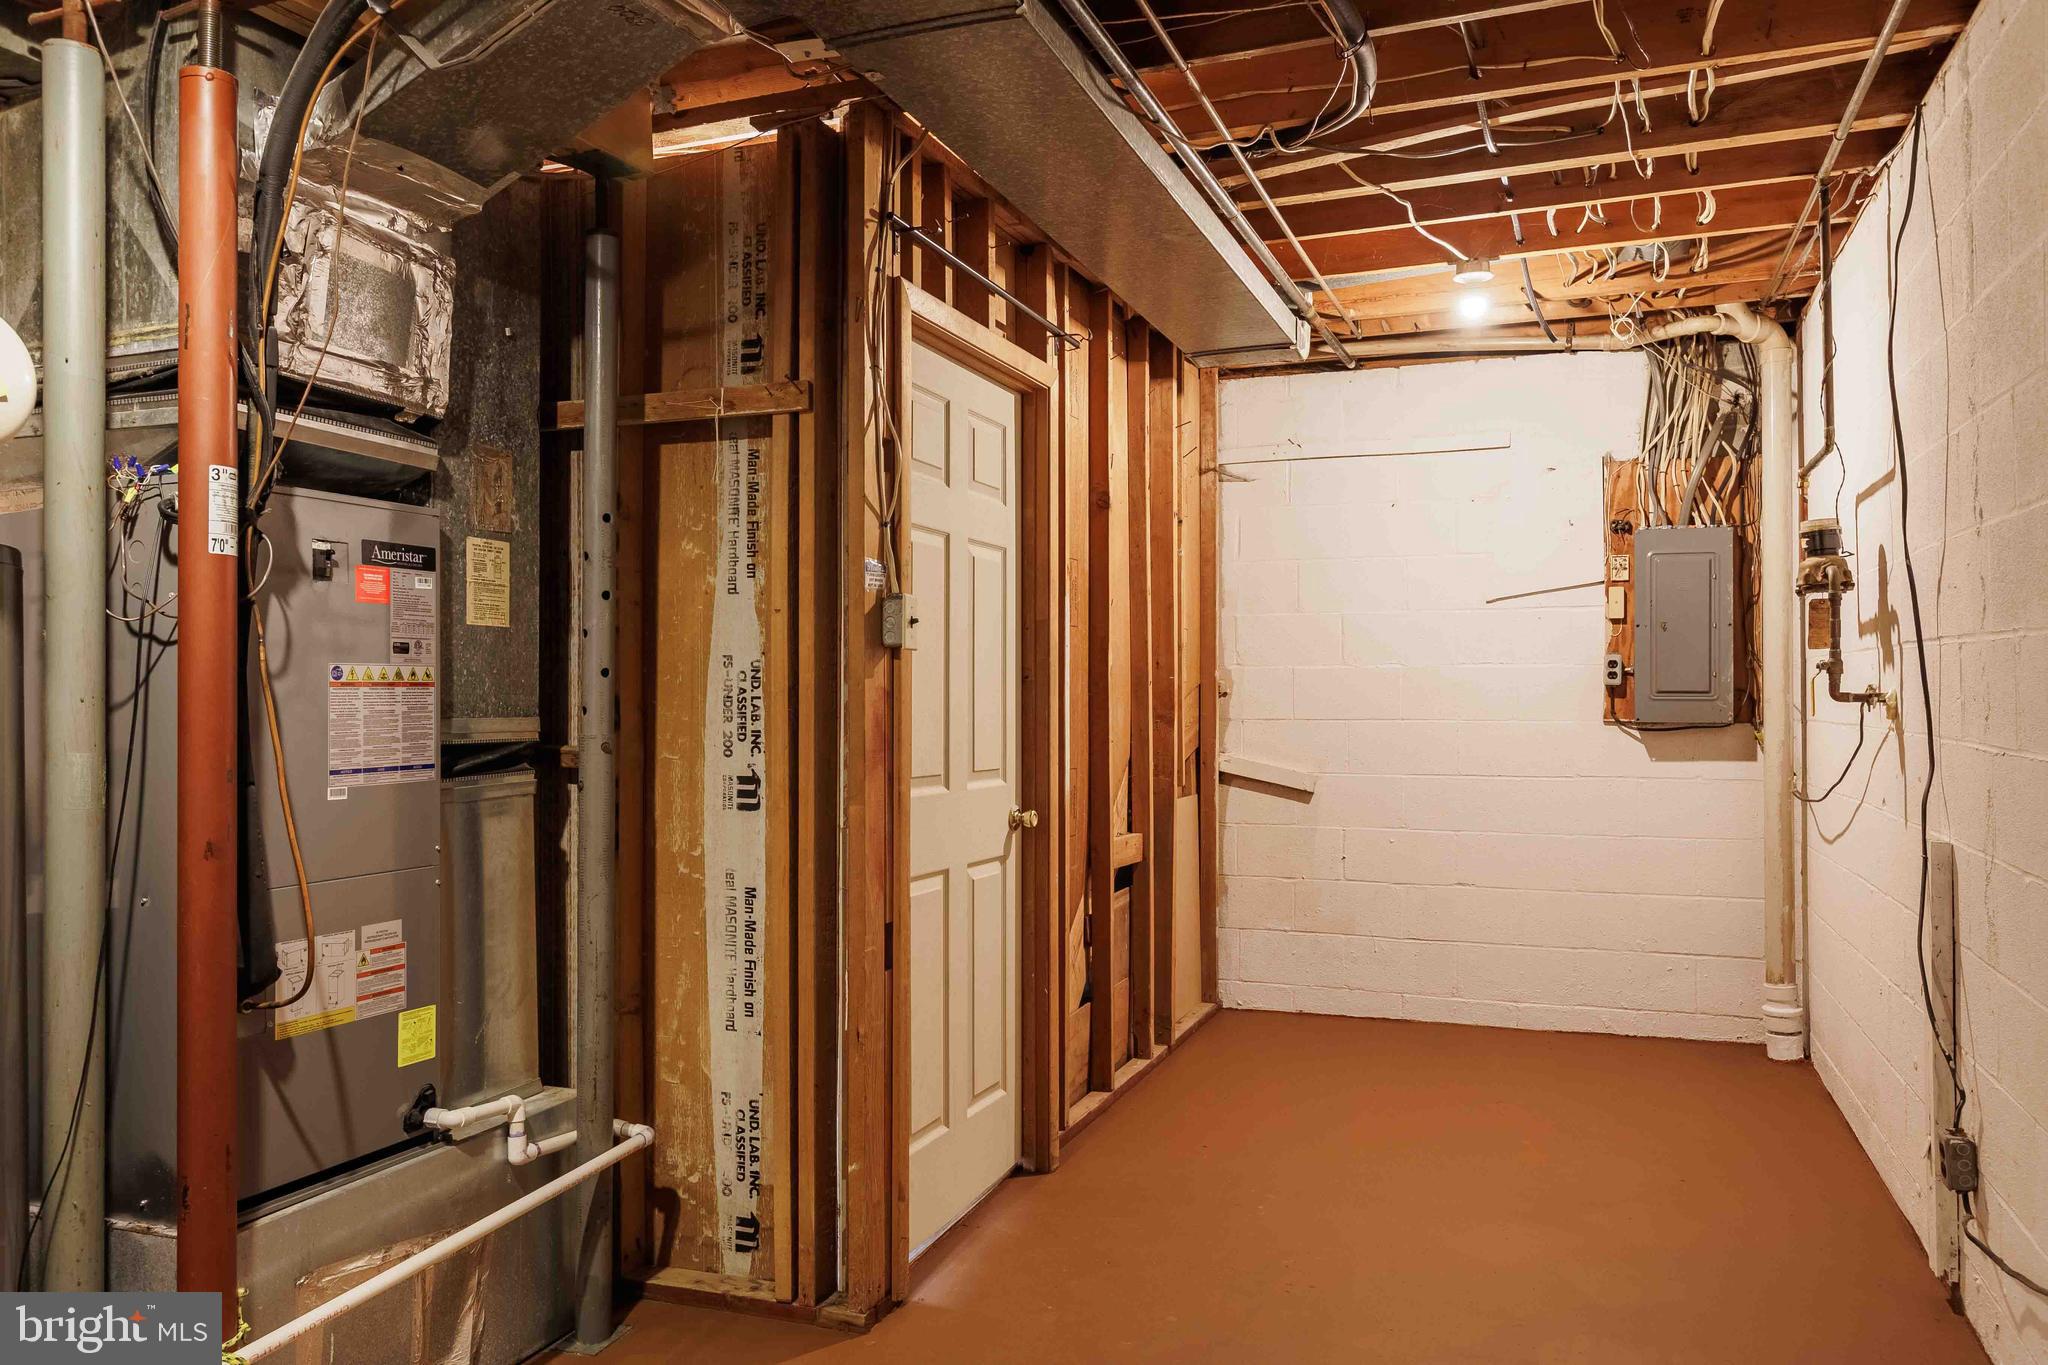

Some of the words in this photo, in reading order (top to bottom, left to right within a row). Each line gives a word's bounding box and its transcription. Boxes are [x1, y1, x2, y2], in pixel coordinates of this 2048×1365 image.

[746, 449, 760, 516] Man-Made
[371, 544, 423, 563] Ameristar
[746, 521, 760, 558] Finish
[727, 531, 740, 595] Hardboard
[746, 563, 757, 579] on
[751, 659, 762, 692] UND.
[737, 670, 747, 743] CLASSIFIED
[751, 695, 761, 726] LAB.
[722, 731, 733, 759] 200
[751, 729, 761, 757] INC.
[745, 887, 757, 955] Man-Made
[744, 959, 757, 996] Finish
[745, 1002, 754, 1018] on
[749, 1100, 760, 1133] UND.
[735, 1109, 746, 1182] CLASSIFIED
[749, 1136, 760, 1166] LAB.
[749, 1170, 760, 1199] INC.
